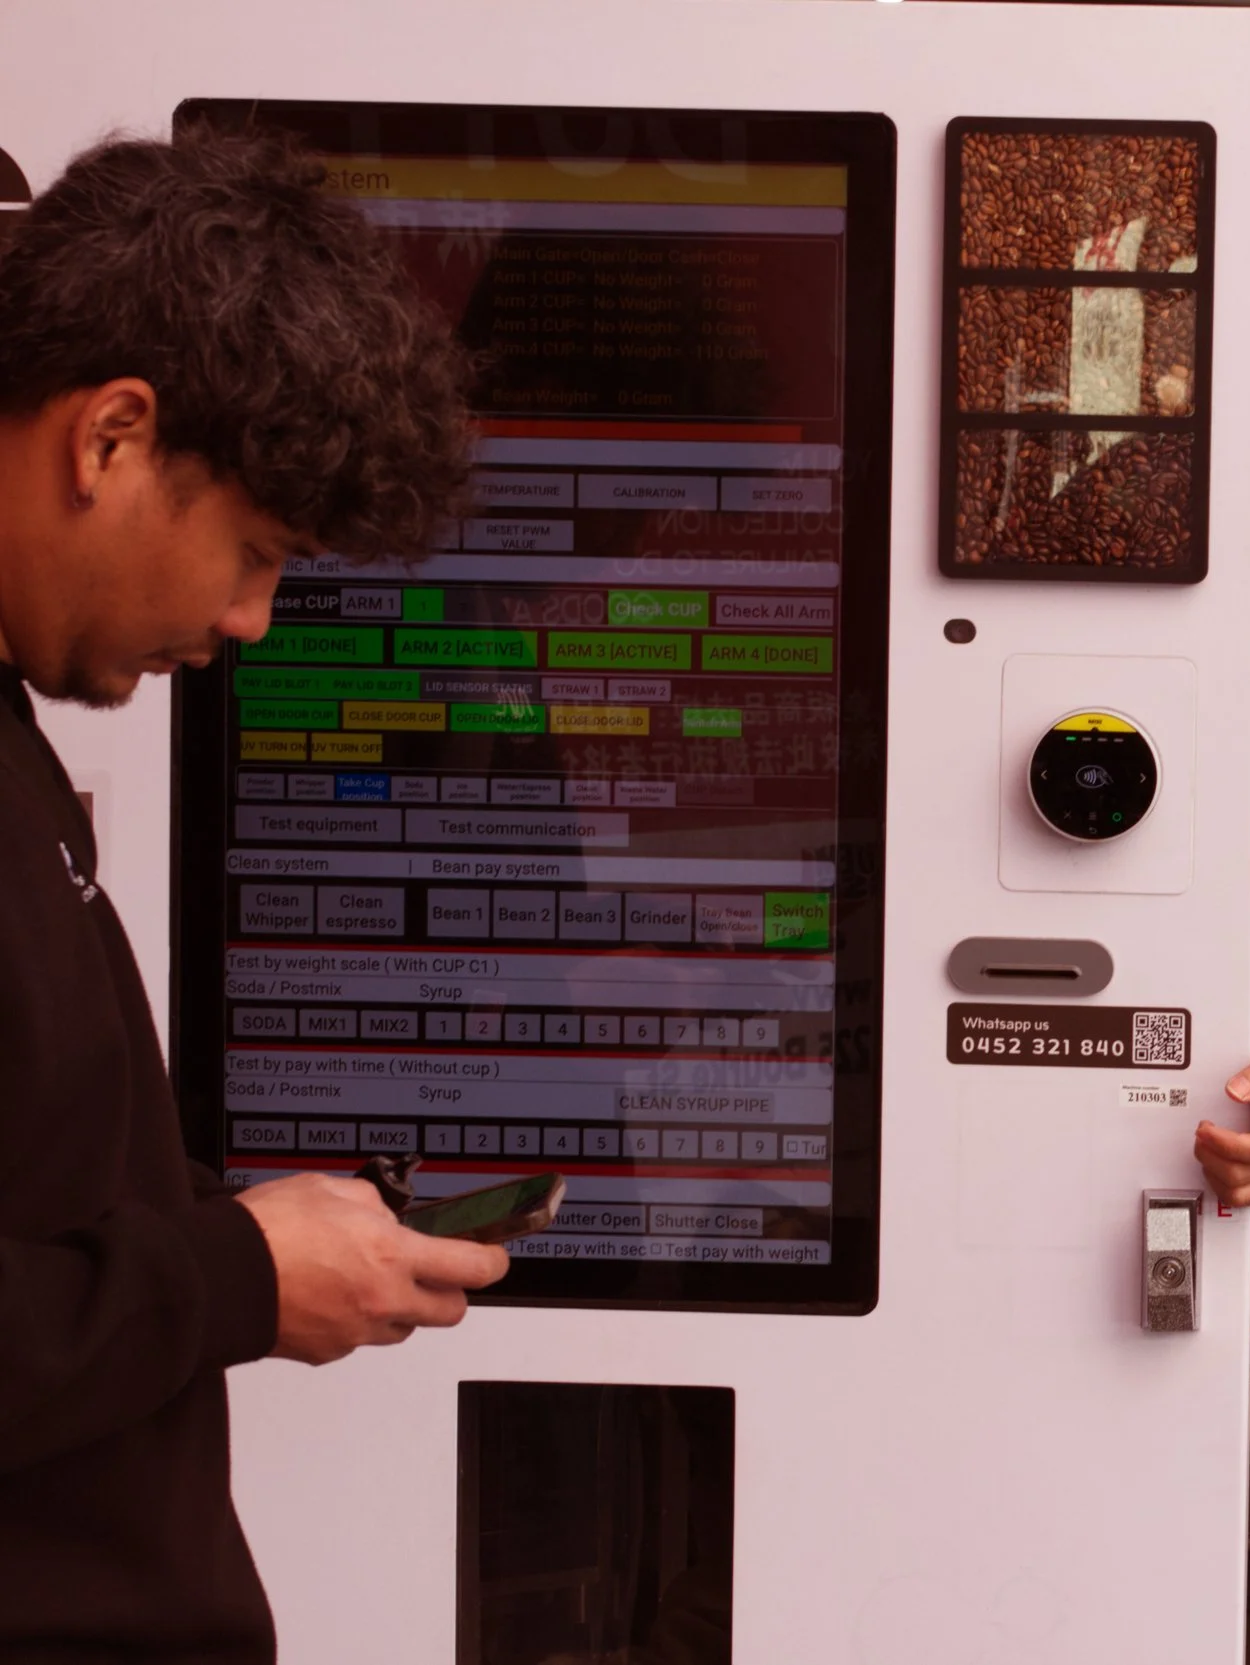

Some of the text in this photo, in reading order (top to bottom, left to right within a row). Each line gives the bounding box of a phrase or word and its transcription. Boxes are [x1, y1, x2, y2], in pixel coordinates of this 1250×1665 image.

[481, 484, 805, 501] TEMPERATURE CALIBRATION SET ZERO
[486, 525, 551, 537] RESET PWM
[501, 538, 537, 550] VALUE
[305, 595, 340, 610] CUP
[346, 595, 395, 611] ARM 1
[615, 602, 703, 618] Check CUP
[722, 603, 831, 620] Check All Arm
[247, 633, 357, 656] ARM 1 [DONE]
[401, 641, 524, 660] ARM 2 [ACTIVE]
[555, 643, 678, 662] ARM 3 [ACTIVE]
[709, 647, 819, 665] ARM 4 [DONE]
[425, 682, 533, 694] LID SENSOR STATUS
[551, 685, 587, 696] STRAW
[617, 686, 667, 697] STRAW 2
[349, 711, 442, 723] CLOSE DOOR CUP
[241, 742, 306, 753] UV TURN ON
[313, 743, 382, 754] UV TURN OFF
[339, 777, 361, 788] Take
[365, 779, 385, 790] Cup
[259, 816, 378, 834] Test equipment
[439, 819, 596, 836] Test communication
[227, 854, 560, 879] Clean system Bean pay system
[255, 892, 299, 907] Clean
[339, 895, 383, 910] Clean
[432, 906, 484, 921] Bean 1
[498, 907, 550, 922] Bean 2
[563, 909, 617, 924] Bean 3
[629, 909, 687, 925] Grinder
[700, 907, 753, 920] Tray Bean
[771, 903, 824, 919] Switch
[246, 911, 310, 930] Whipper
[325, 917, 398, 932] espresso
[699, 921, 758, 934] Open/close
[772, 923, 806, 939] Tray
[228, 955, 488, 974] Test by weight scale With CUP C1
[227, 980, 342, 997] Soda Postmix
[419, 984, 463, 1001] Syrup
[242, 1016, 287, 1031] SODA
[308, 1017, 347, 1032] MIX1
[369, 1018, 409, 1033] MIX2
[439, 1020, 447, 1034] 1
[478, 1021, 489, 1036] 2
[517, 1021, 528, 1036] 3
[557, 1022, 568, 1037] 4
[597, 1023, 608, 1038] 5
[637, 1024, 648, 1038] 6
[962, 1016, 1050, 1033] Whatsapp us
[676, 1025, 687, 1039] 7
[716, 1026, 727, 1040] 8
[756, 1027, 766, 1041] 9
[962, 1036, 1125, 1057] 0452 321 840
[228, 1055, 491, 1078] Test by pay with time Without cup
[227, 1081, 342, 1098] Soda Postmix
[418, 1085, 462, 1103] Syrup
[619, 1095, 770, 1113] CLEAN SYRUP PIPE
[1127, 1091, 1166, 1104] 210303
[241, 1128, 286, 1143] SODA
[307, 1129, 346, 1144] MIX1
[368, 1130, 408, 1145] MIX2
[438, 1132, 446, 1146] 1
[477, 1133, 488, 1148] 2
[516, 1133, 527, 1148] 3
[557, 1134, 567, 1149] 4
[596, 1135, 607, 1150] 5
[636, 1136, 646, 1151] 6
[675, 1137, 686, 1152] 7
[715, 1138, 726, 1153] 8
[755, 1138, 765, 1153] 9
[552, 1211, 642, 1230] hutter Open
[655, 1213, 759, 1230] Shutter Close
[519, 1240, 647, 1257] Test pay with sec
[666, 1243, 820, 1263] Test pay with weight
